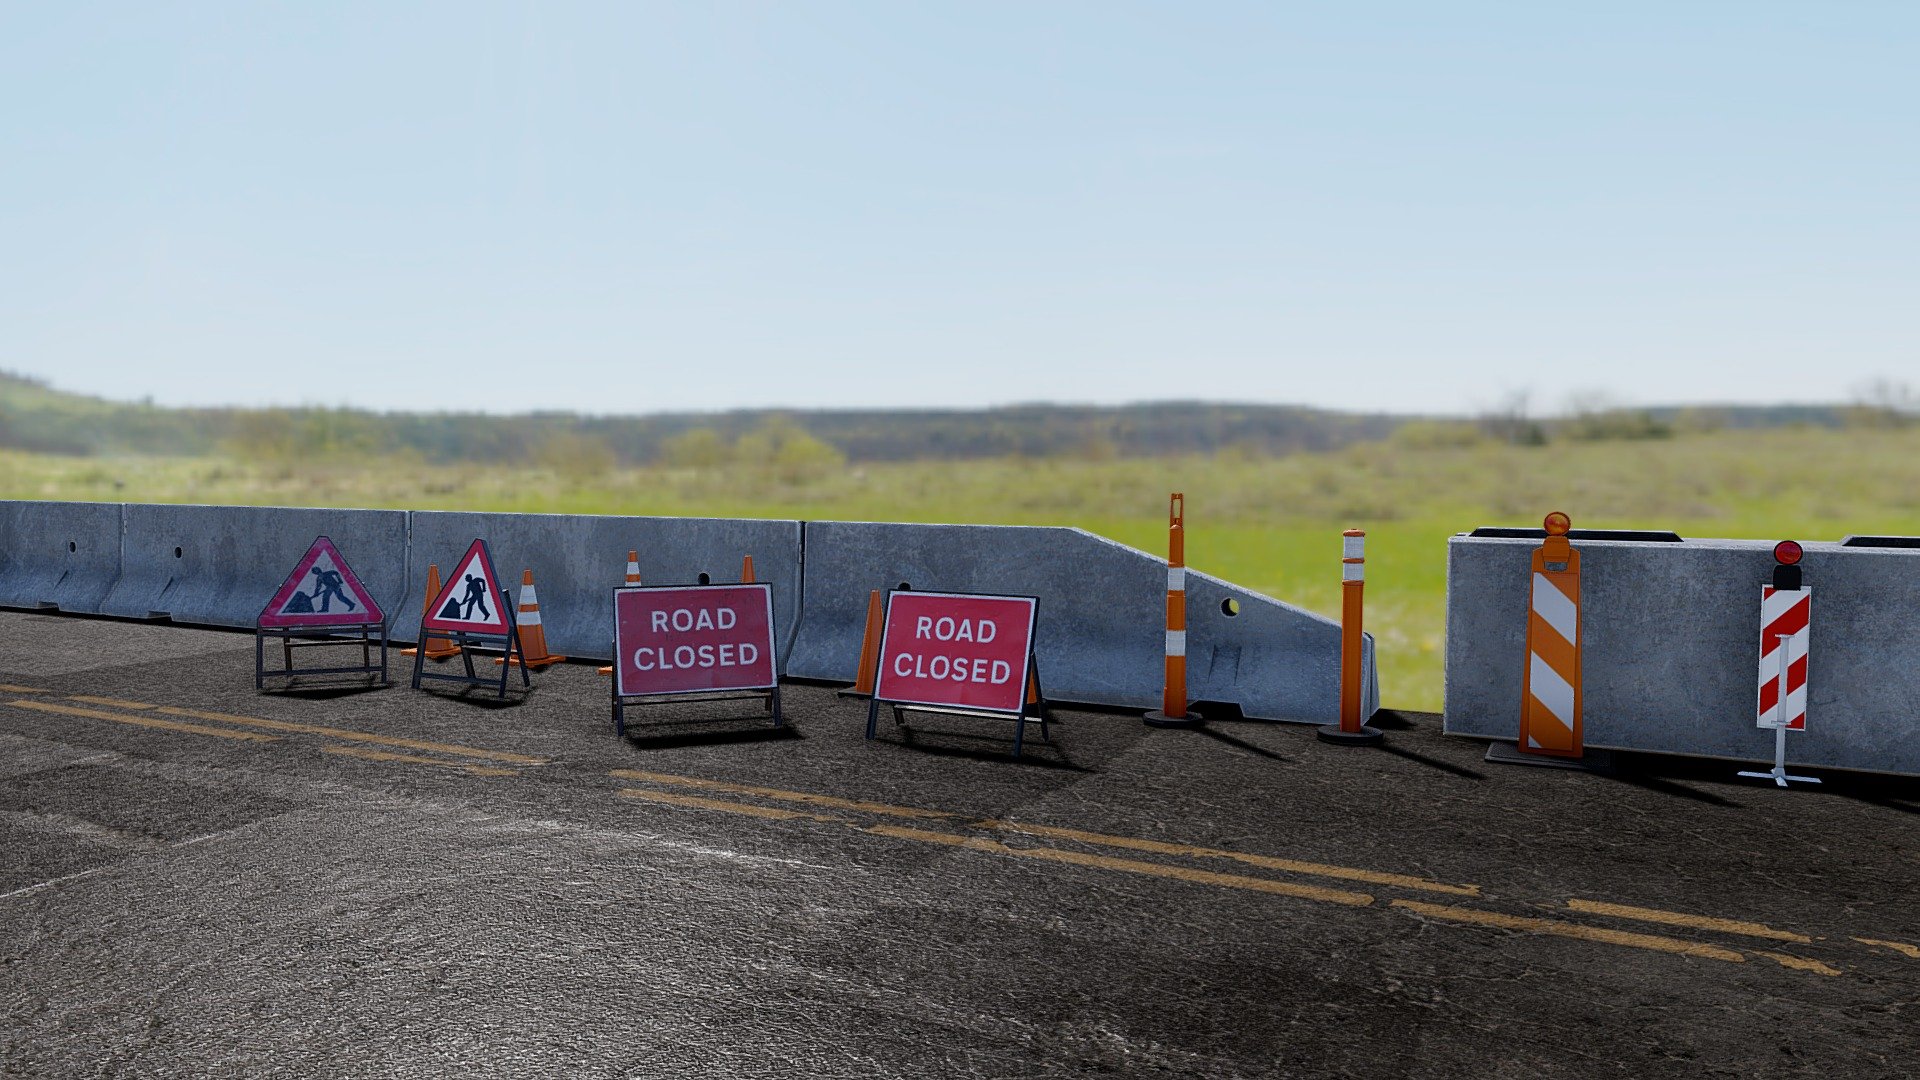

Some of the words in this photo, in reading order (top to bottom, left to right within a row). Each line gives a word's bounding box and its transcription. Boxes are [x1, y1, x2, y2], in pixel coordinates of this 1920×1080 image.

[651, 608, 737, 633] ROAD
[916, 616, 997, 643] ROAD
[634, 643, 758, 671] CLOSED
[894, 652, 1011, 685] CLOSED
